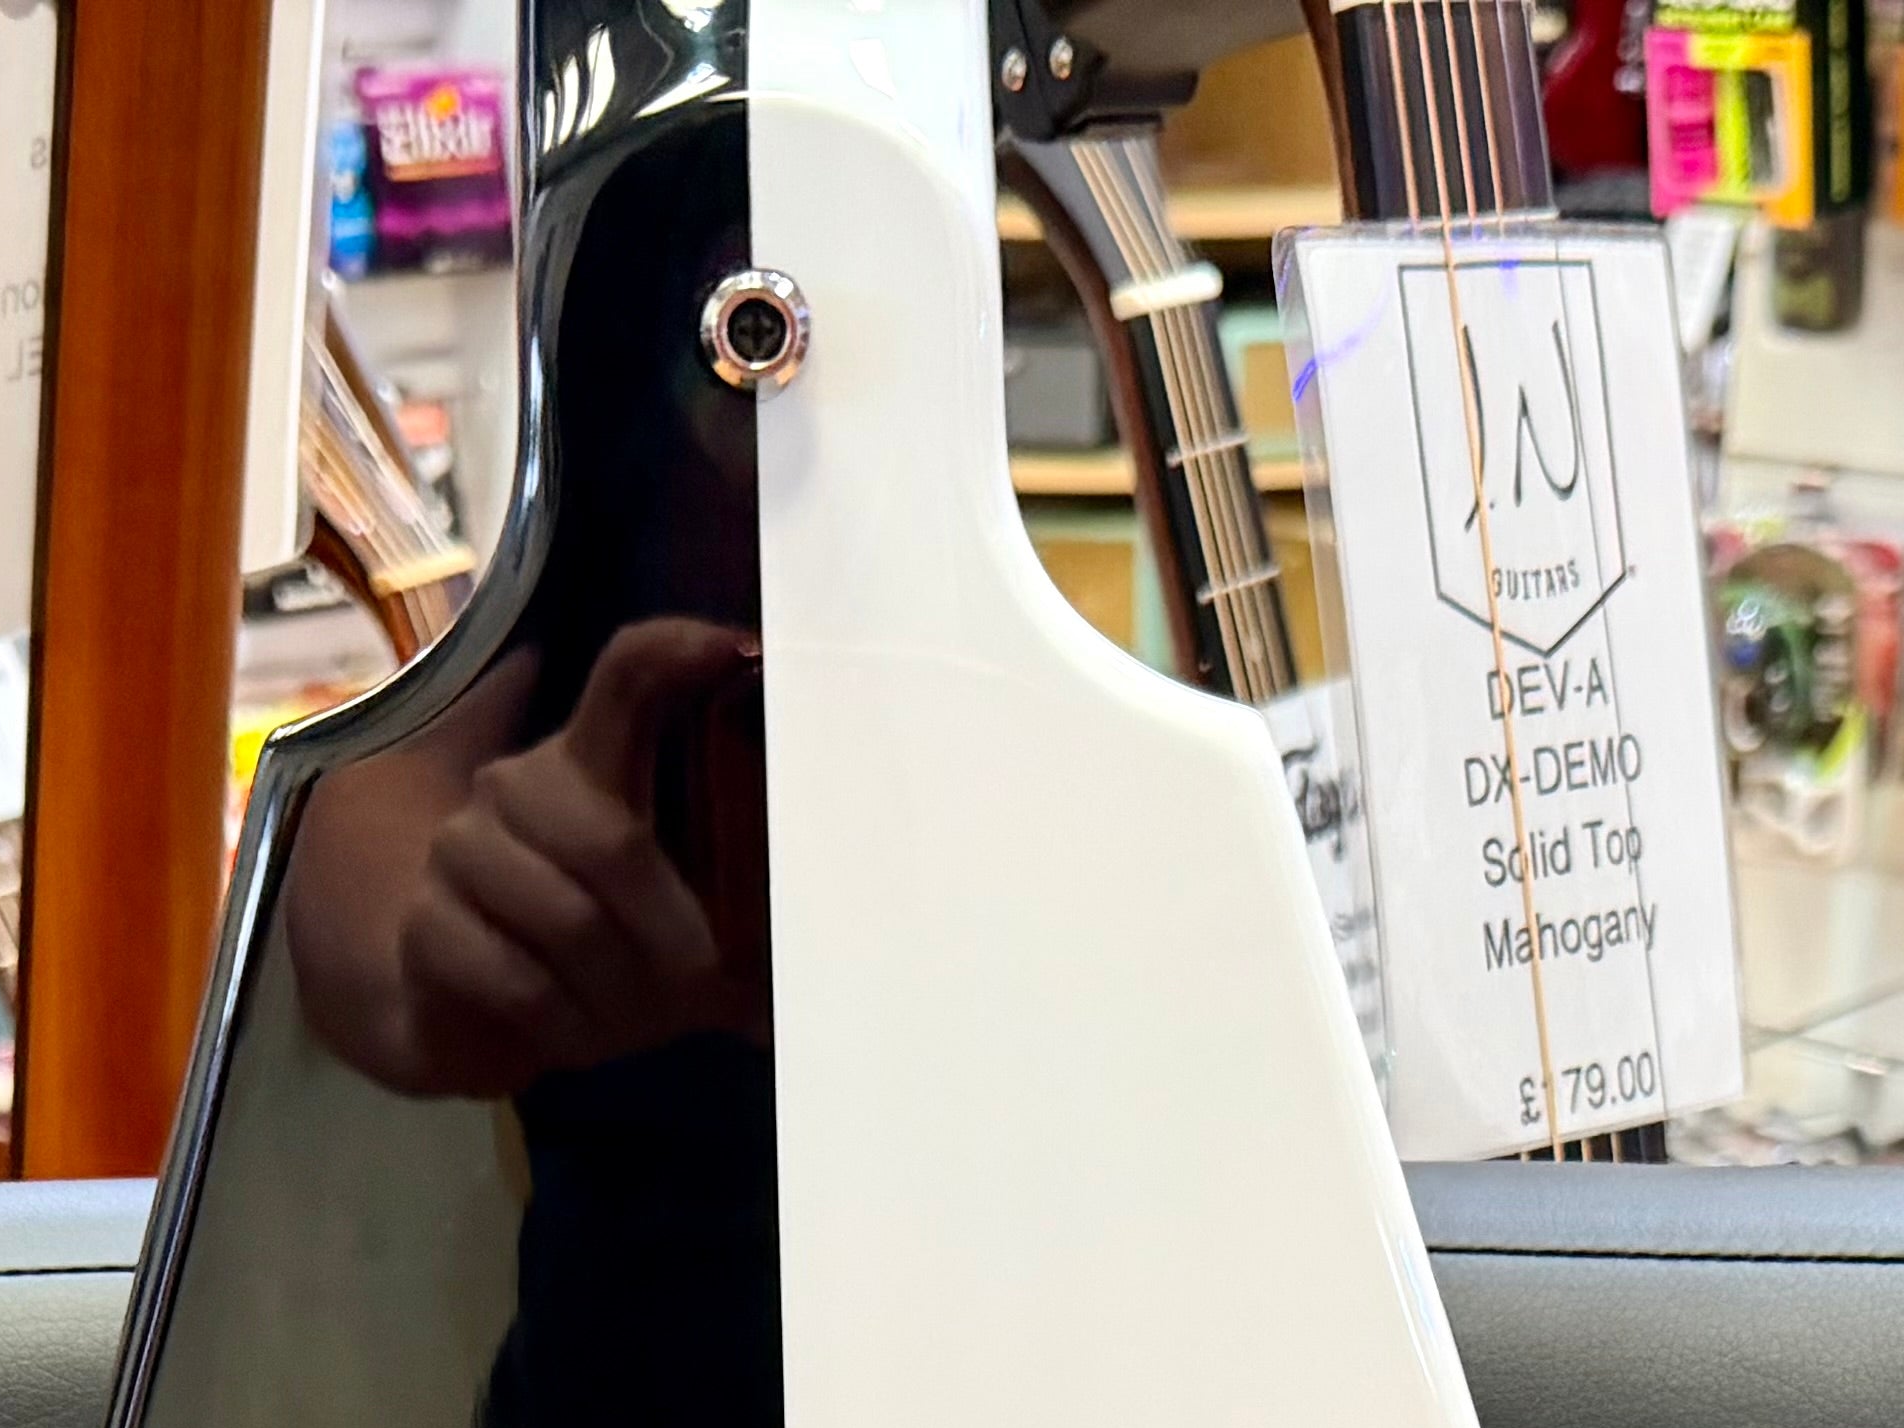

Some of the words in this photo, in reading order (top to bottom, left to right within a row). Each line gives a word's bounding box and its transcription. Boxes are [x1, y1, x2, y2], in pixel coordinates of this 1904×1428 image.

[1491, 556, 1581, 601] GUITARS
[1486, 657, 1609, 721] DEV-A
[1464, 734, 1643, 808] DX-DEMO
[1482, 826, 1572, 888] Solid
[1582, 819, 1643, 876] Top
[1482, 902, 1657, 973] Mahogany
[1519, 1051, 1657, 1127] £79.00
